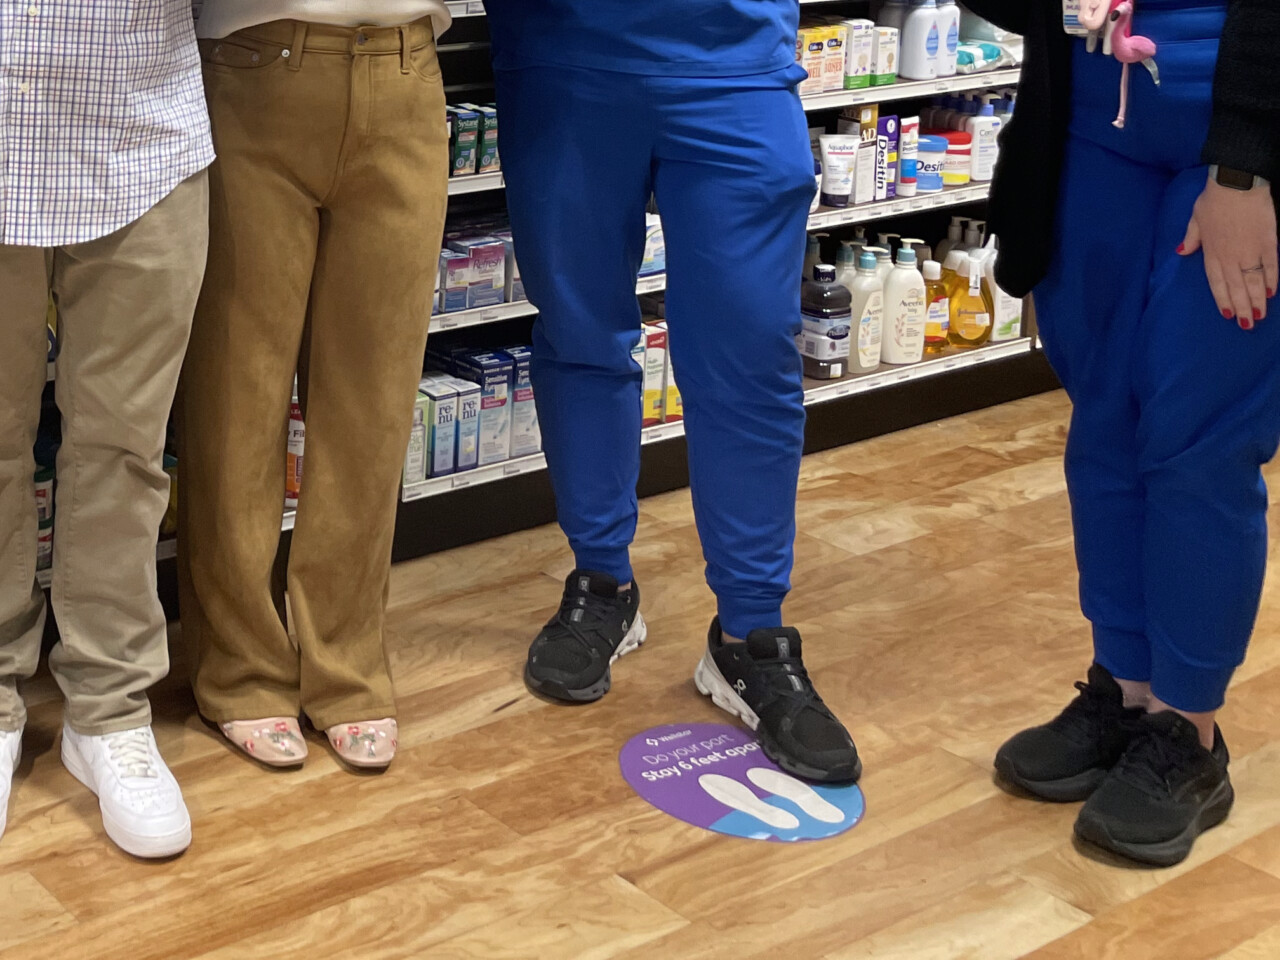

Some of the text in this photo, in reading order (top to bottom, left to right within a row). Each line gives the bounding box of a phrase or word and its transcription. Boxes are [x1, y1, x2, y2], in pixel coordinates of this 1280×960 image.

[828, 143, 854, 152] Aquaphor
[877, 139, 888, 190] Desitin
[473, 258, 502, 271] Refresh
[899, 299, 924, 307] Aveeno
[485, 374, 508, 384] Sensitive
[438, 413, 453, 425] nu
[462, 408, 477, 420] nu
[658, 729, 692, 742] Wellstar
[643, 733, 735, 765] Do your part
[641, 764, 681, 781] Stay
[678, 761, 693, 770] 6
[690, 751, 727, 767] feet
